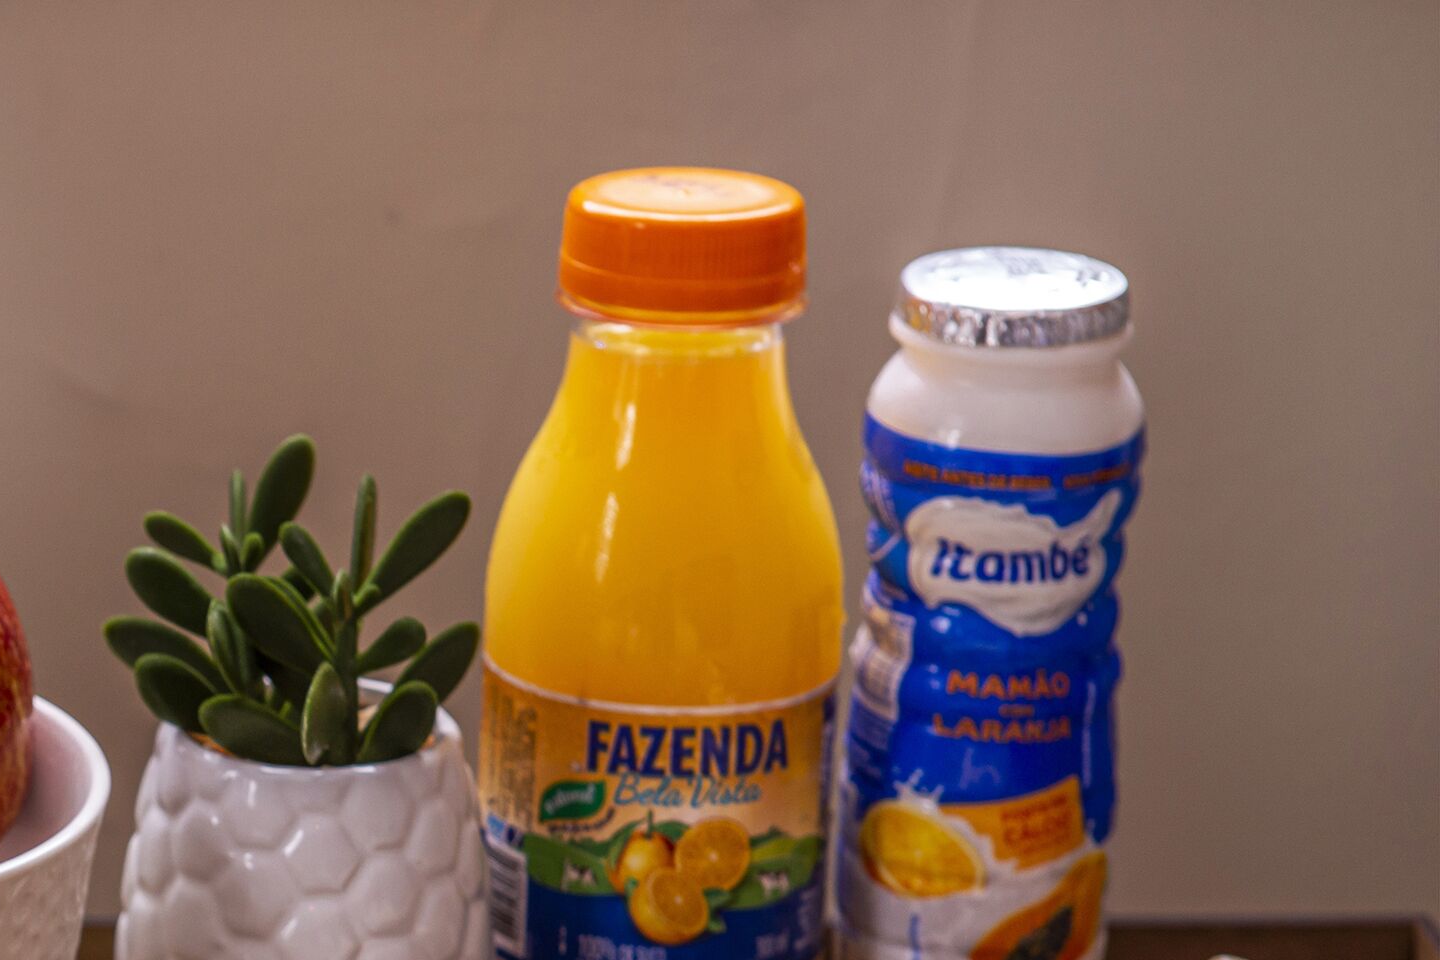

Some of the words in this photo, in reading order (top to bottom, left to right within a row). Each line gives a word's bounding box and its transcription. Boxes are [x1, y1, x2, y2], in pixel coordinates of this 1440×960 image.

[945, 667, 1071, 700] MAMÃO
[932, 713, 1071, 744] LARANJA
[585, 718, 789, 778] FAZENDA
